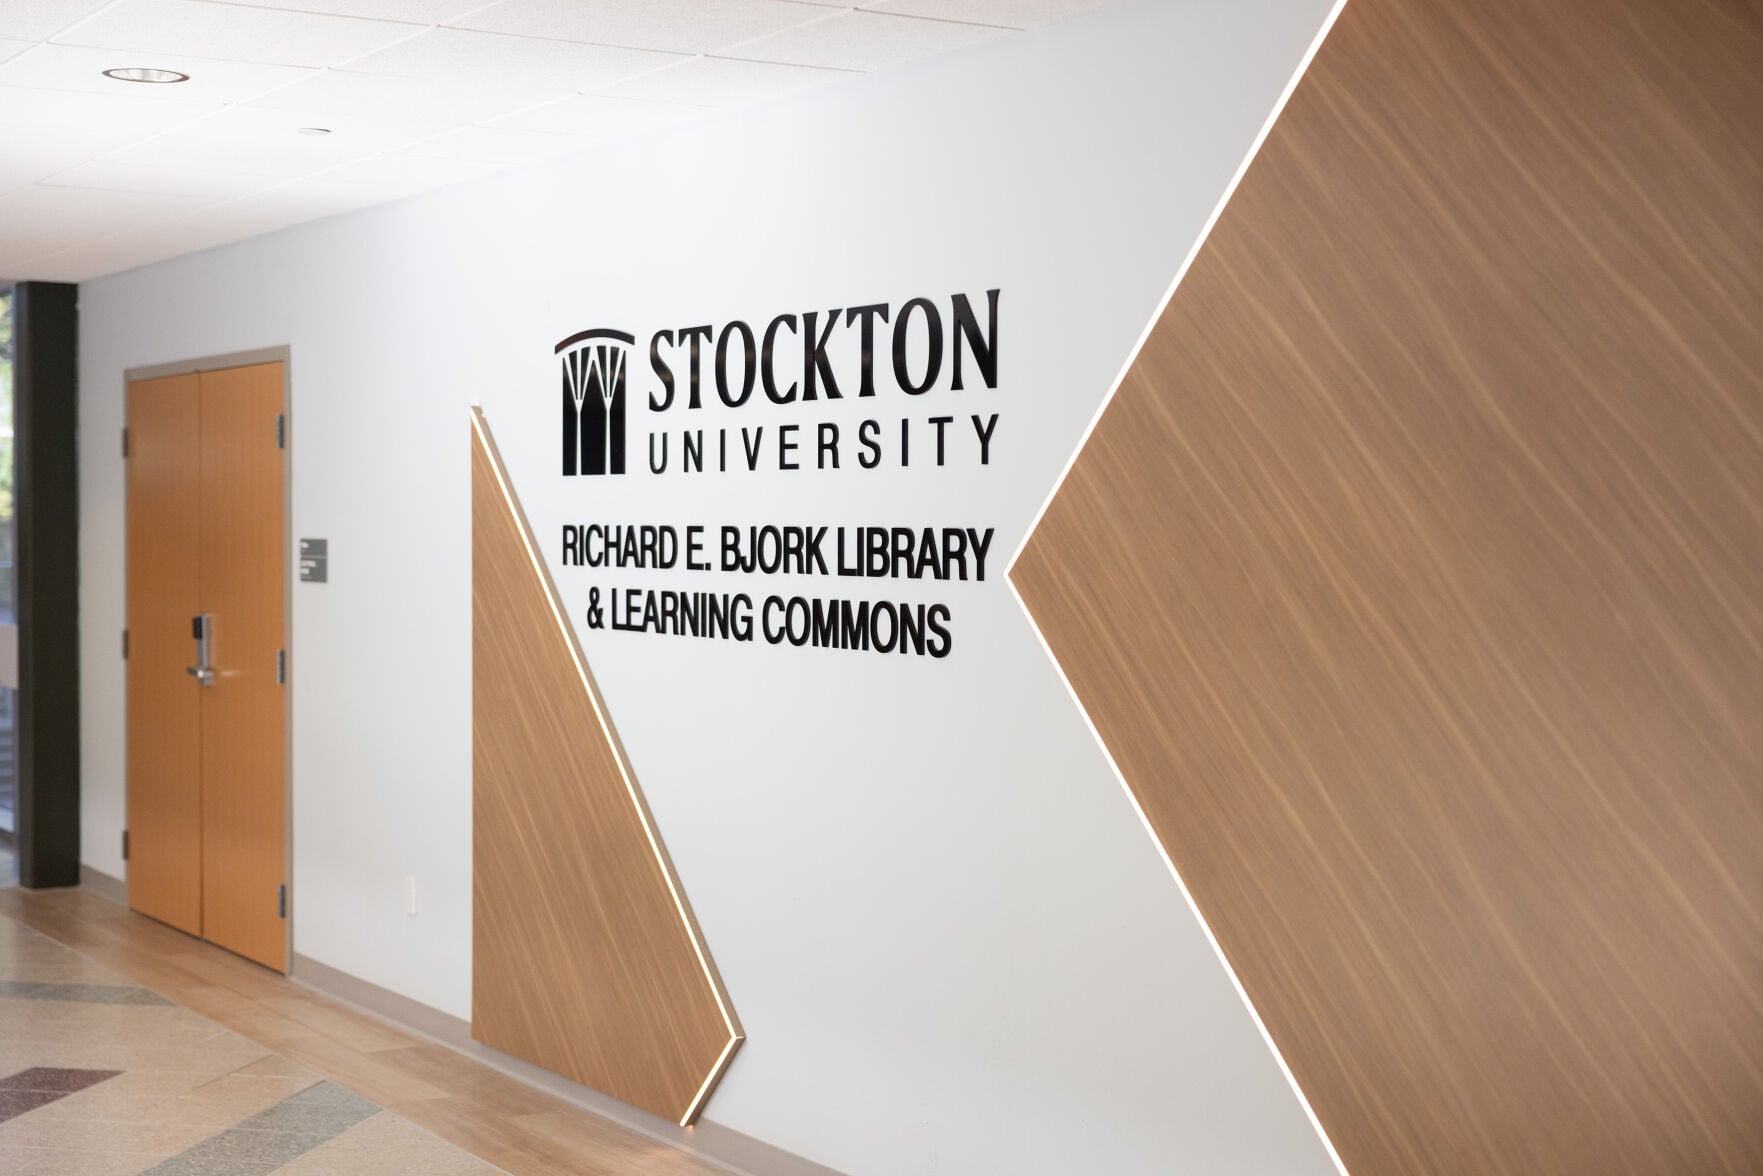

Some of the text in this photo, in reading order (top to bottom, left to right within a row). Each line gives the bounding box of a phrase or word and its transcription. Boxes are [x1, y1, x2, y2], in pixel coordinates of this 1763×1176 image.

[648, 288, 1001, 413] STOCKTON
[649, 413, 1000, 475] UNIVERSITY
[562, 523, 995, 582] RICHARD E. BJORK LIBRARY
[586, 586, 952, 659] & LEARNING COMMONS
